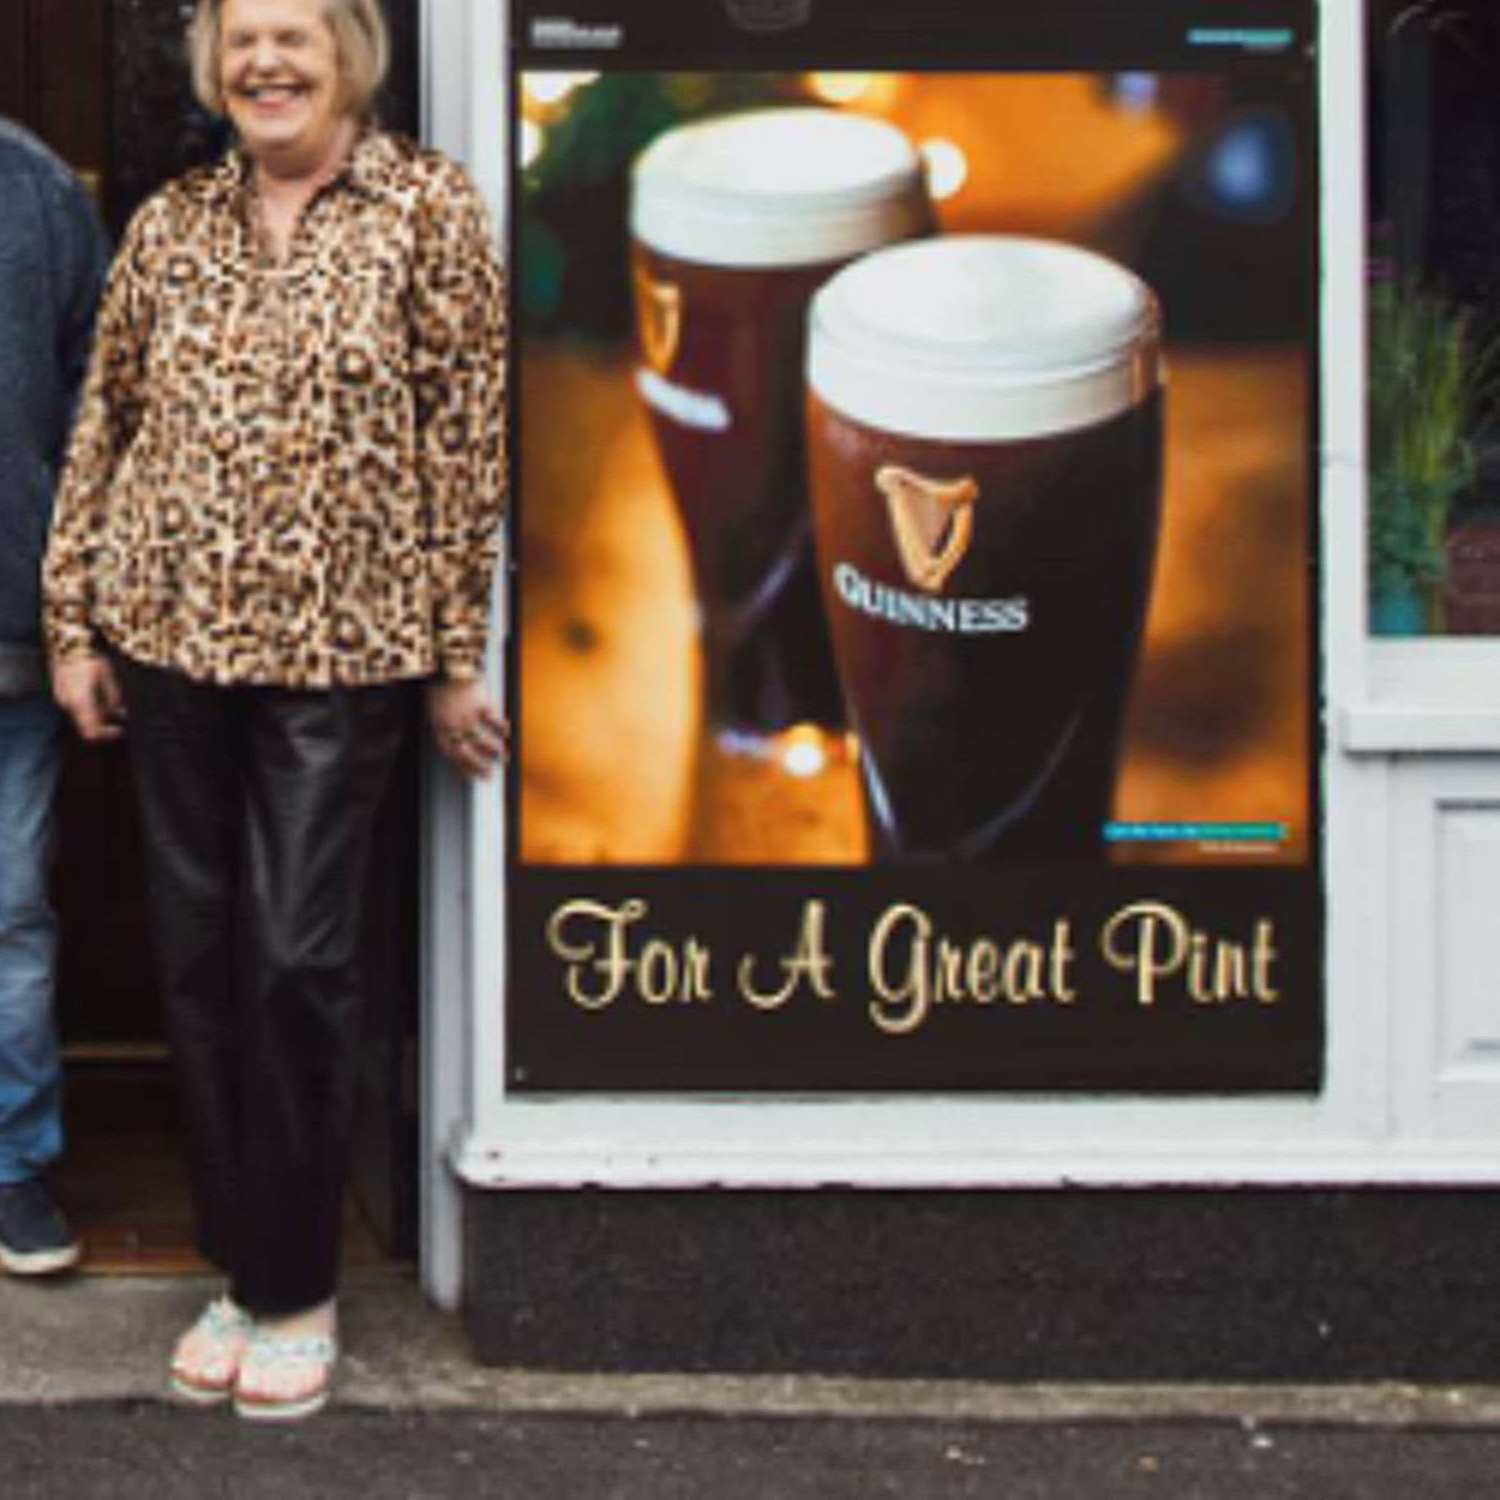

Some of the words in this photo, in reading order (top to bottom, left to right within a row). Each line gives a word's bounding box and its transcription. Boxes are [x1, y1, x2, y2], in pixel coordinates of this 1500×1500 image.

[834, 562, 1028, 632] GUINNESS
[547, 899, 713, 1010] For
[738, 900, 835, 1010] A
[867, 902, 1076, 1034] Great
[1101, 901, 1278, 1004] Pint
